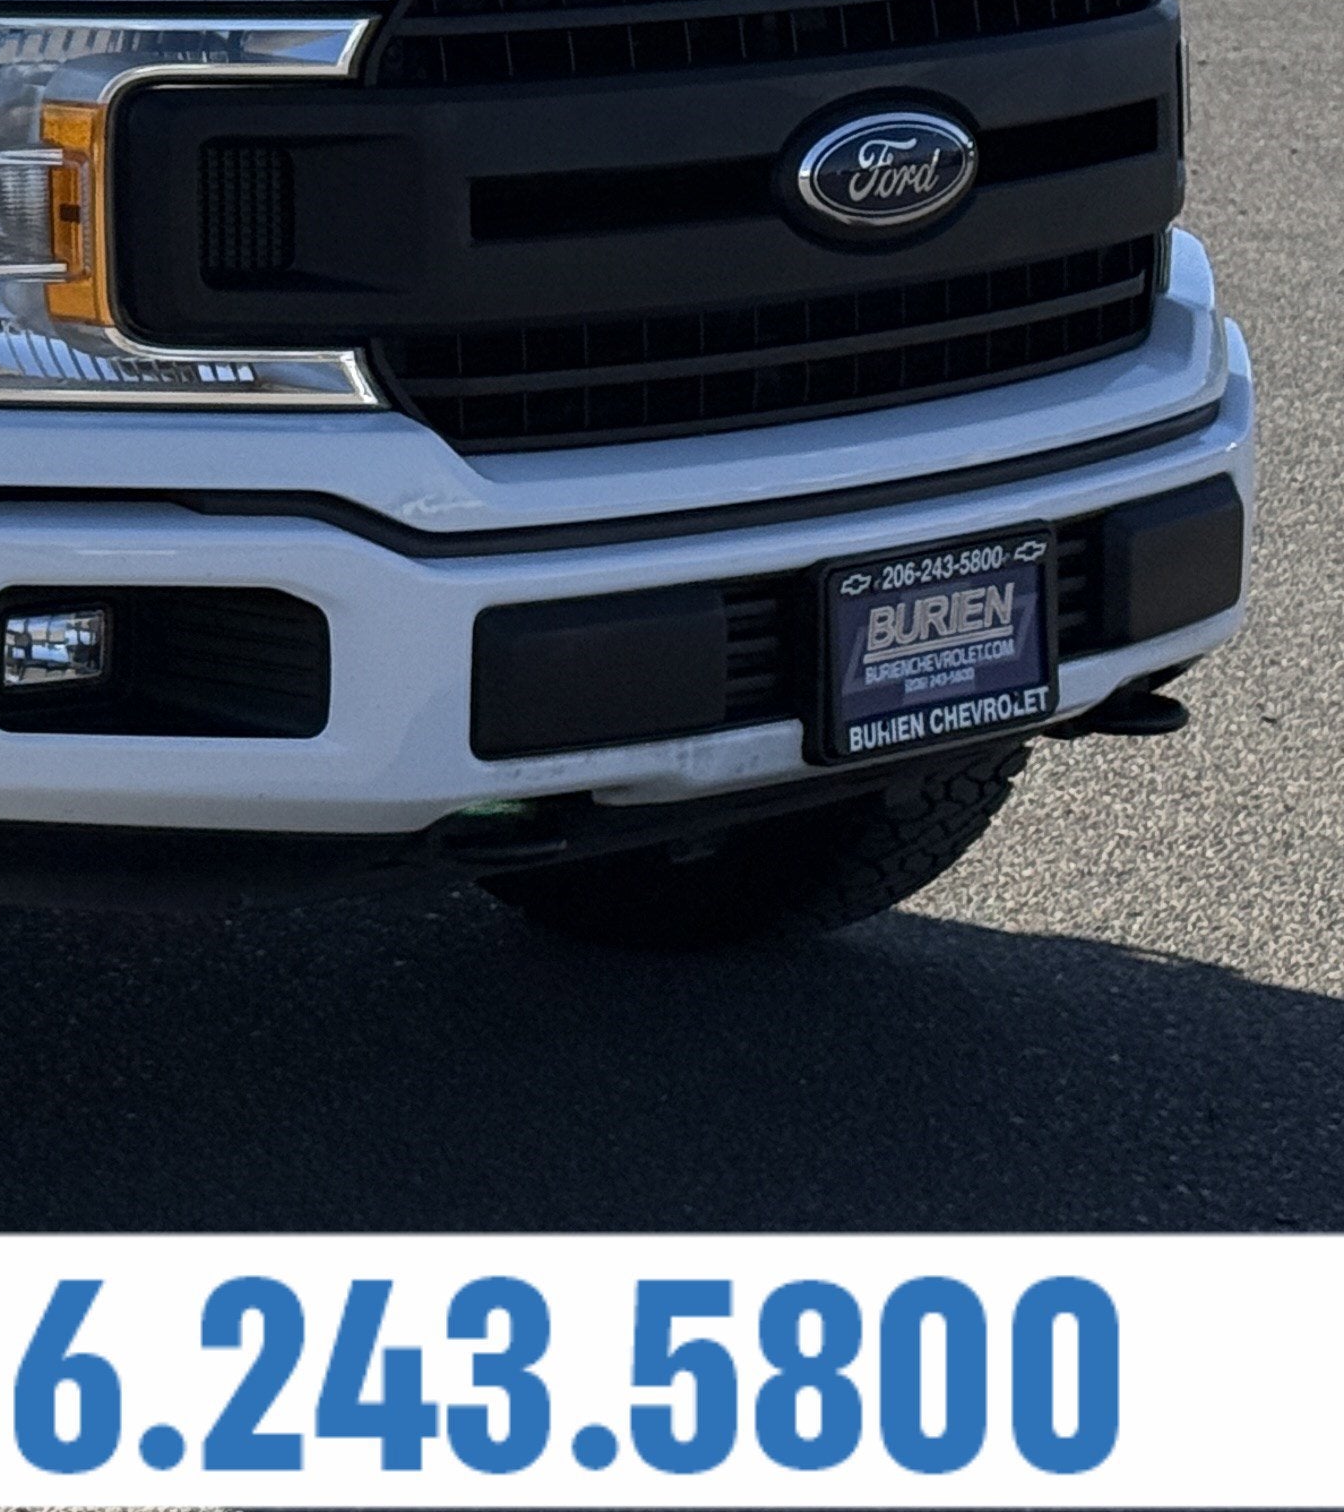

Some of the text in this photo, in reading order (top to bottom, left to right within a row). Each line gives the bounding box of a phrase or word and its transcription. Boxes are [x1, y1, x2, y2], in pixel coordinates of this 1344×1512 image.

[848, 137, 941, 202] Ford
[881, 545, 1004, 590] 206-243-5800
[867, 582, 1015, 651] BURIEN
